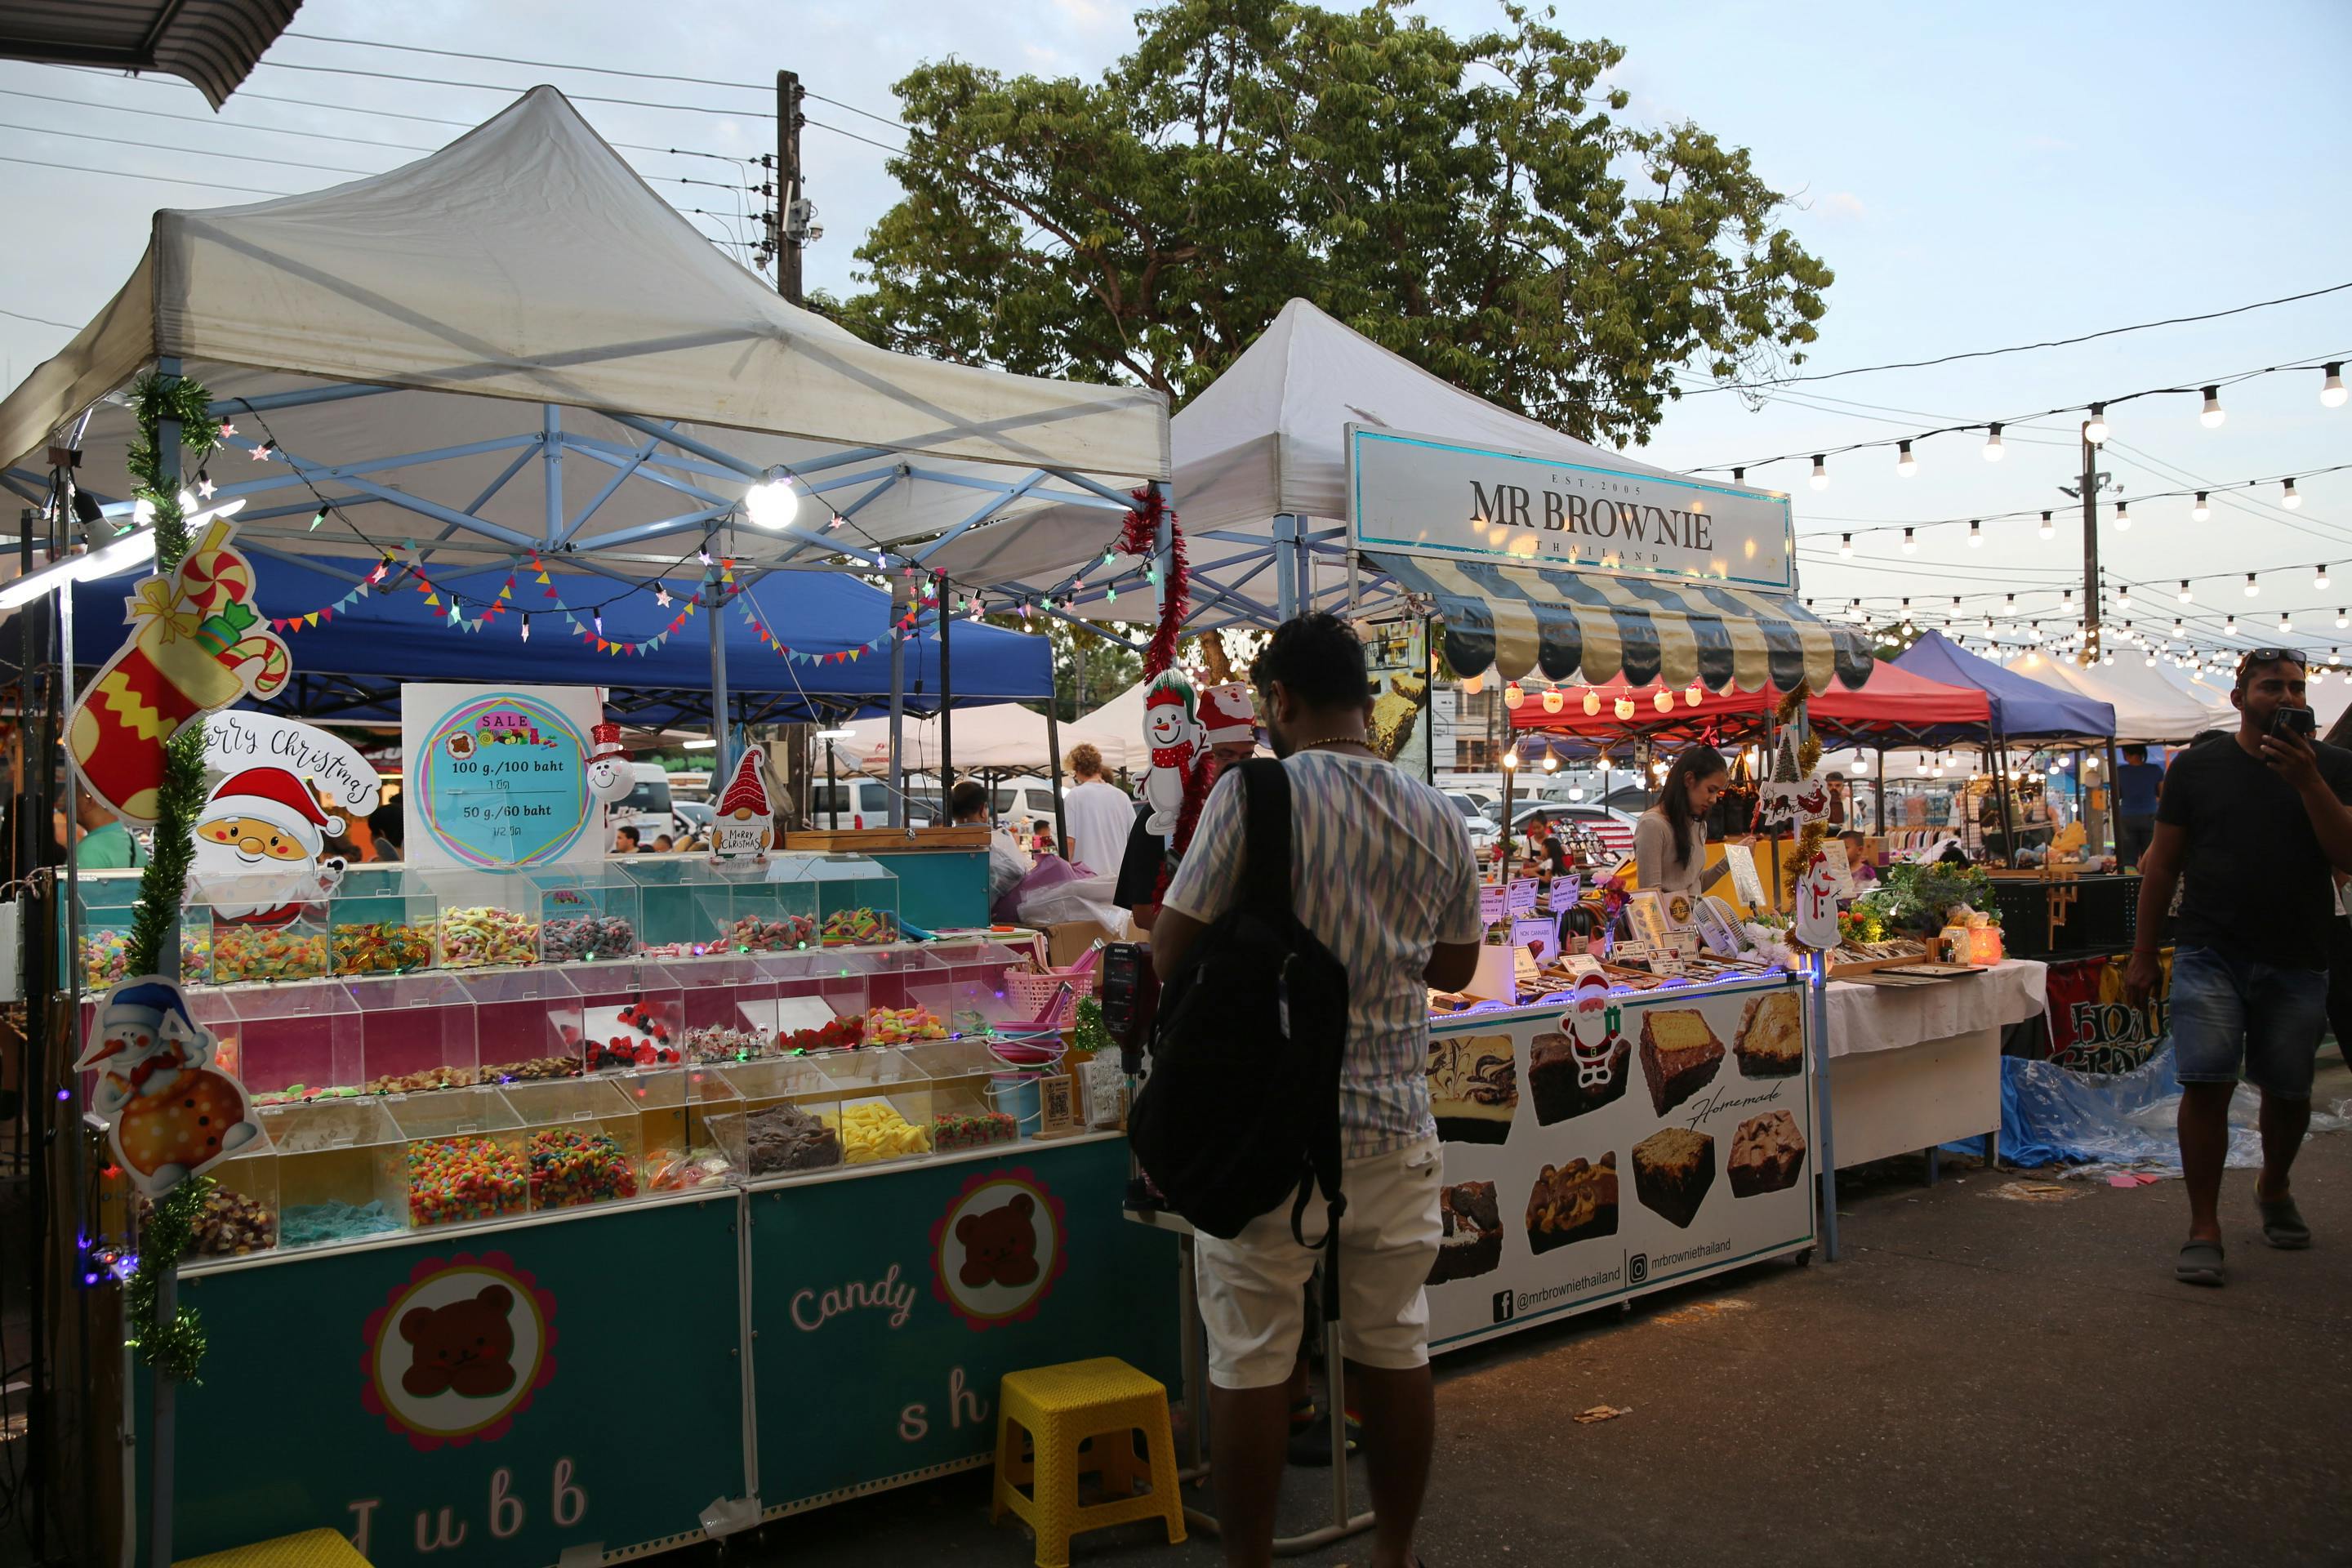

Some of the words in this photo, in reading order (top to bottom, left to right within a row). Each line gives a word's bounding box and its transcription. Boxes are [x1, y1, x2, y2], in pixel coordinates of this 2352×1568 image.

[1469, 480, 1535, 528] MR
[1543, 490, 1713, 551] BROWNIE
[1535, 540, 1659, 563] THAILAND
[483, 716, 528, 727] SALE
[207, 717, 259, 755] erry
[271, 729, 373, 804] Christmas
[452, 762, 478, 773] 100
[483, 761, 529, 776] g./100
[534, 761, 564, 772] baht
[463, 807, 479, 818] 50
[523, 805, 552, 816] baht
[1686, 1080, 1783, 1133] Homemade
[1651, 1238, 1731, 1270] mrbrowniethailand
[791, 1263, 917, 1331] Candy
[1517, 1267, 1621, 1311] @mrbrowniethailand
